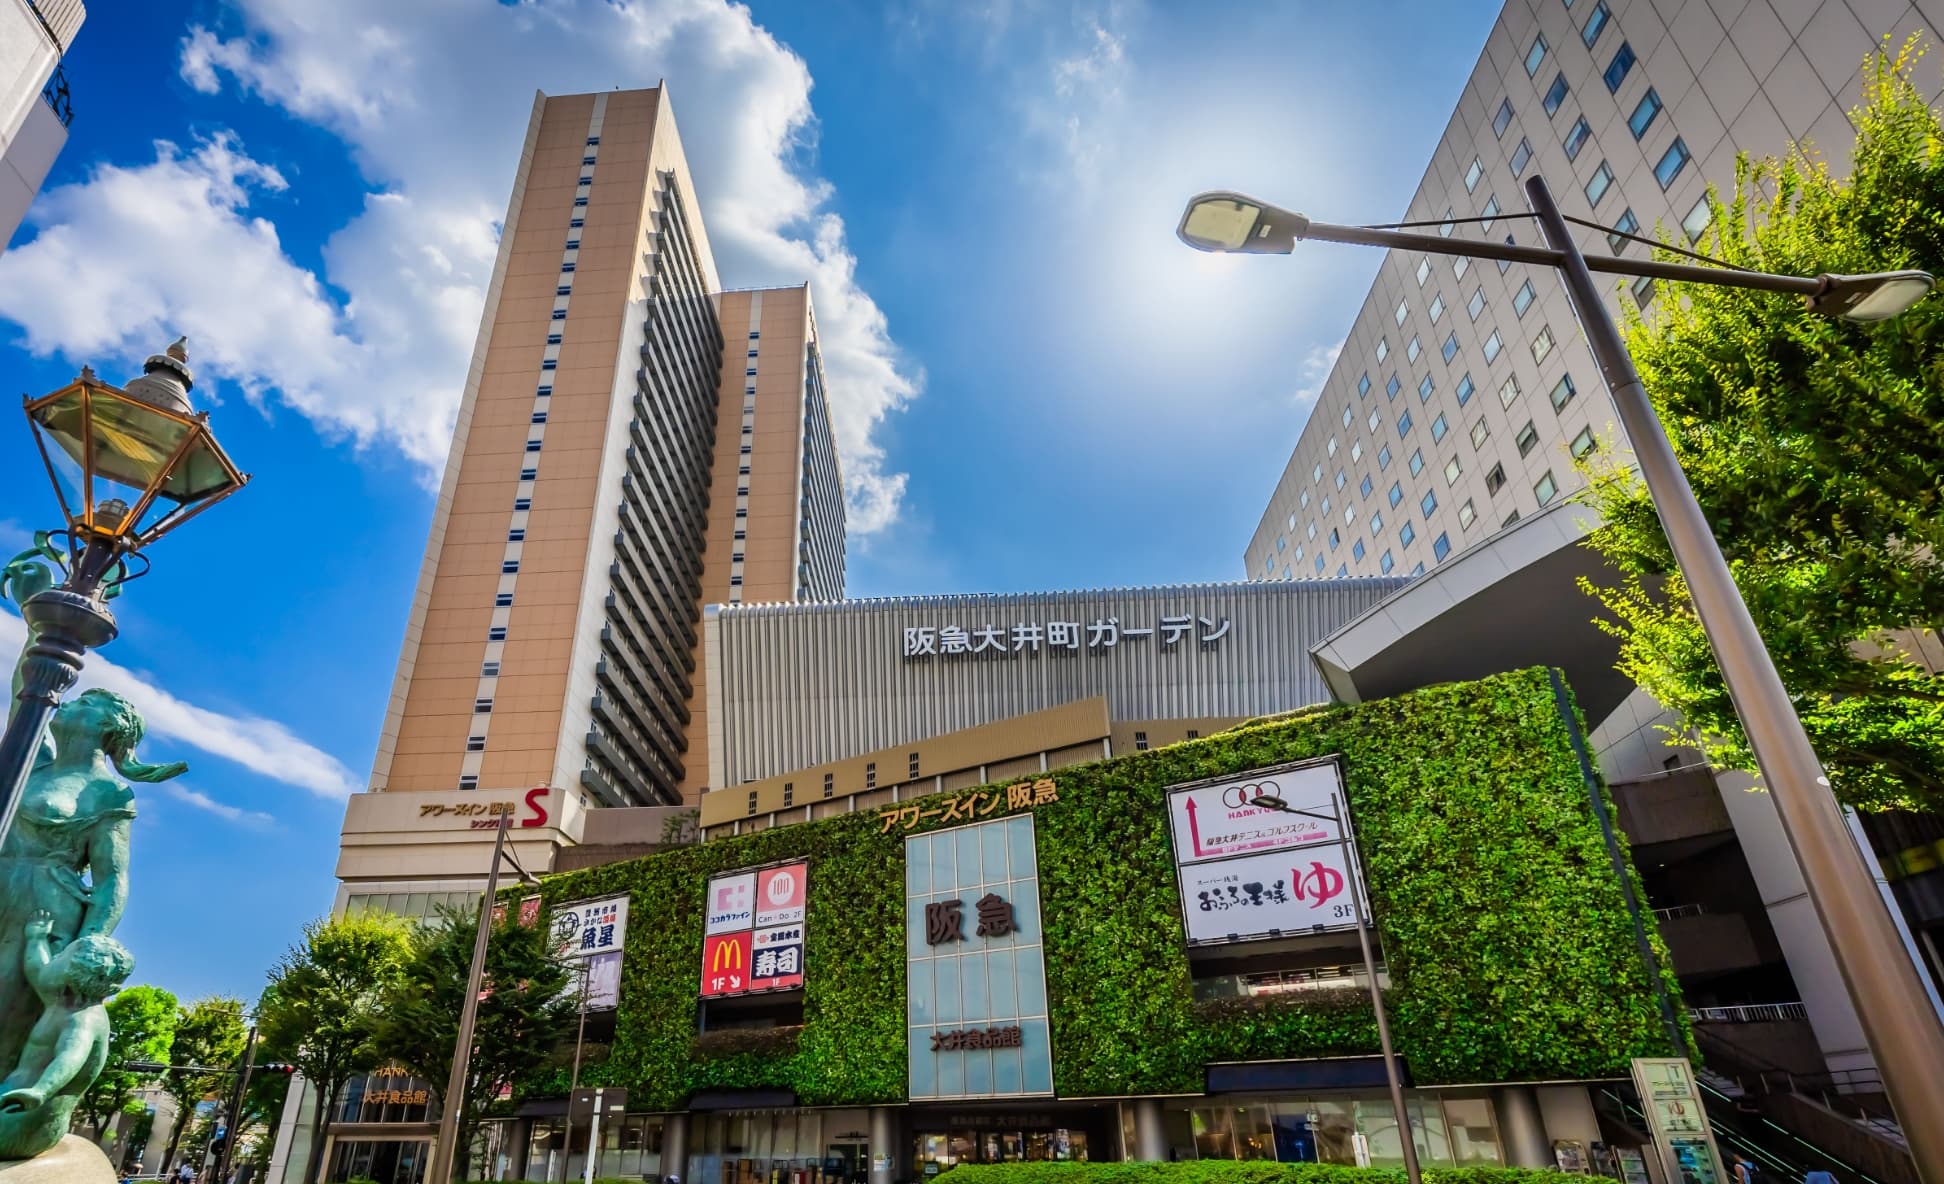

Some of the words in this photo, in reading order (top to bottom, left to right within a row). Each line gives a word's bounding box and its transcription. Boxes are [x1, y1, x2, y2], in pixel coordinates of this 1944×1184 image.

[904, 613, 1230, 656] 阪急大井町ガーデン
[419, 803, 488, 817] アワーズイン
[521, 788, 549, 827] S
[879, 792, 1000, 833] アワーズイン
[1007, 778, 1060, 810] 阪急
[1197, 879, 1290, 912] おふろの王様
[1291, 861, 1344, 909] ゆ
[709, 911, 751, 925] ココカラファイン
[758, 916, 773, 924] Can
[779, 912, 790, 921] Do
[793, 910, 802, 919] 2F
[925, 892, 1017, 946] 阪急
[1333, 904, 1354, 918] 3F
[580, 924, 615, 950] 魚星
[755, 946, 799, 977] 寿司
[711, 976, 726, 991] 1F
[772, 978, 781, 987] 1F
[930, 1025, 1022, 1052] 大井食品館
[373, 1065, 420, 1078] HANK
[364, 1089, 428, 1105] 大井食品館
